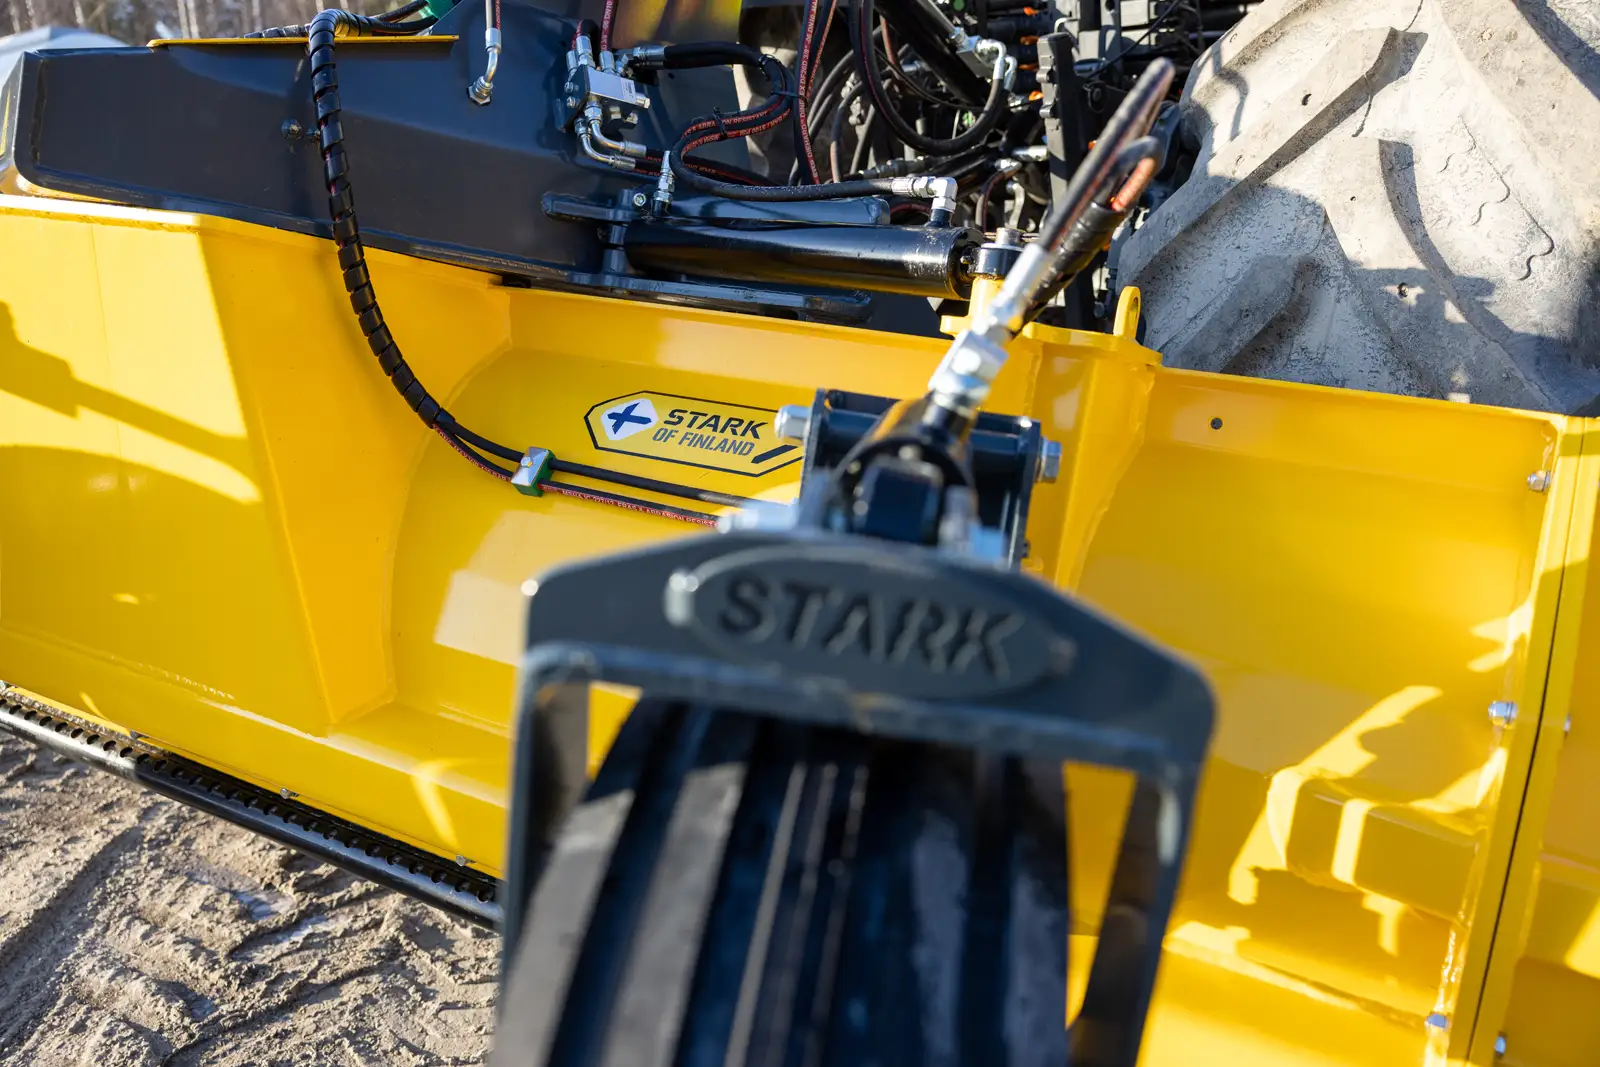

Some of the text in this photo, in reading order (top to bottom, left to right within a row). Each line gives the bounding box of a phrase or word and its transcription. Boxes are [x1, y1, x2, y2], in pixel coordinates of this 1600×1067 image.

[664, 409, 768, 440] STARK
[652, 428, 755, 457] OF FINLAND
[720, 575, 1024, 681] STARK
